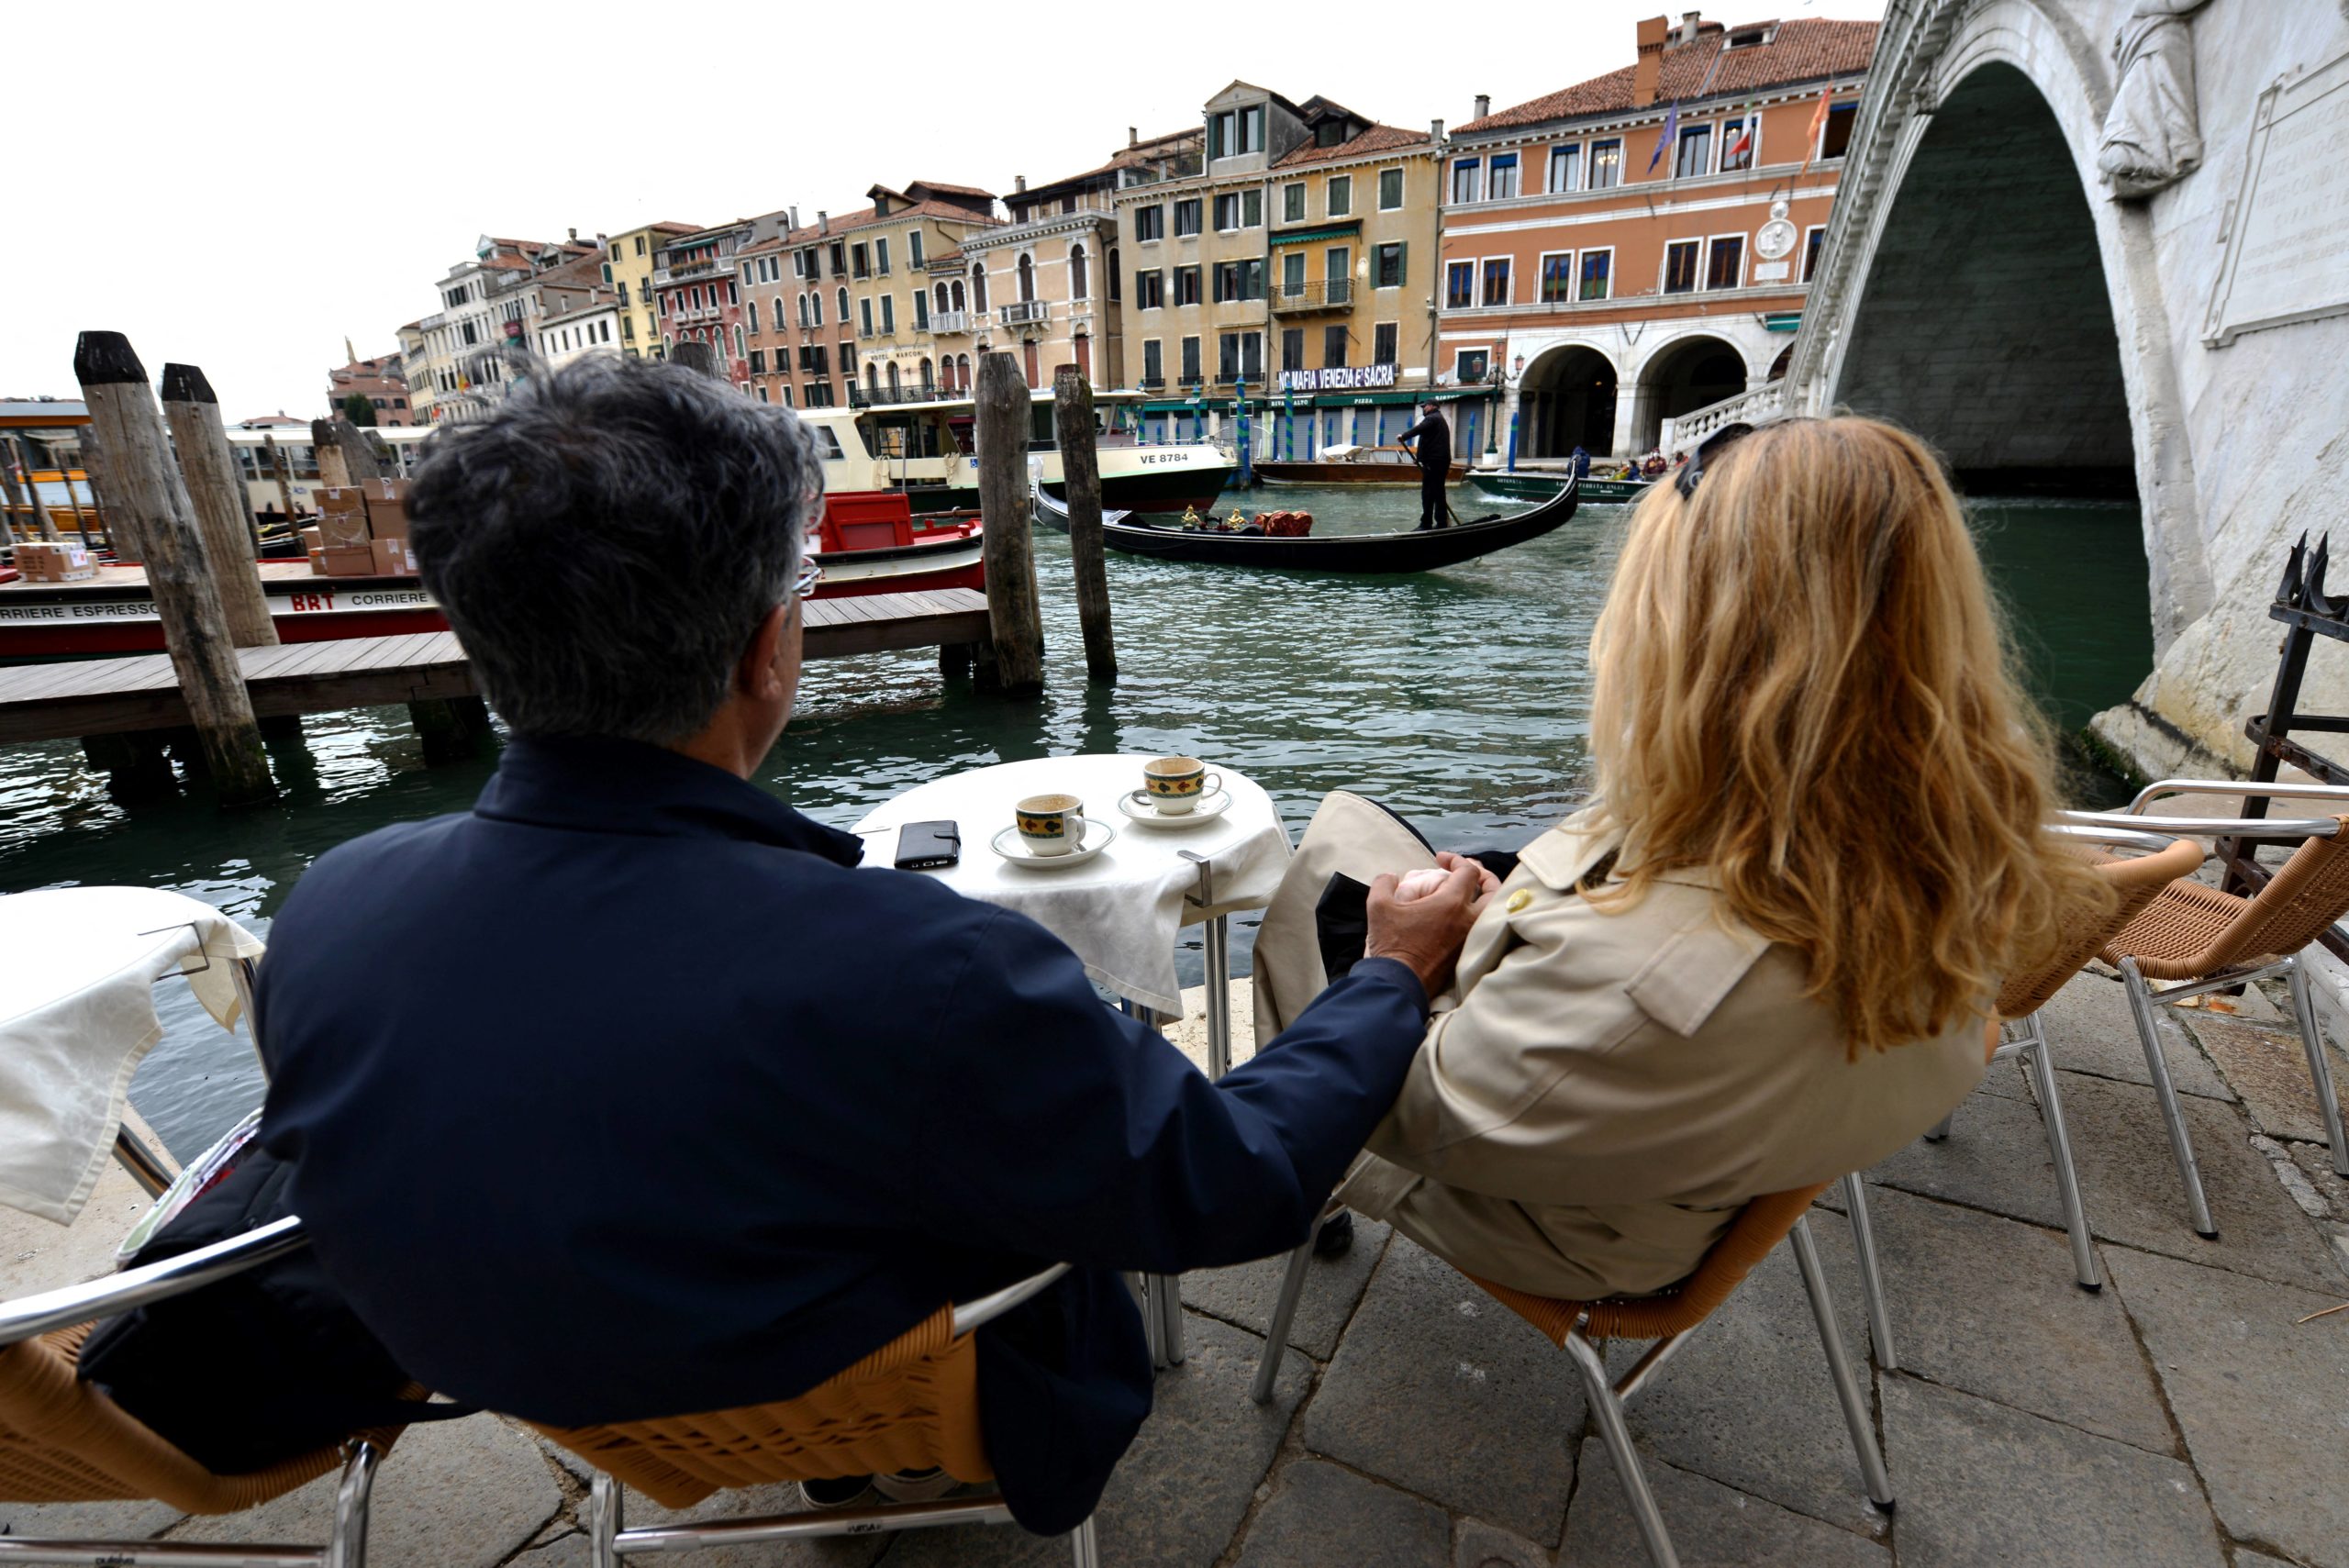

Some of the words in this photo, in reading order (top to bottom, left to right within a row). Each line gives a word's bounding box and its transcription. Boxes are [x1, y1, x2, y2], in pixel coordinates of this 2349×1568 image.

[1292, 370, 1316, 390] MAFIA
[1319, 368, 1353, 389] VENEZIA
[1364, 365, 1394, 386] SACRA
[1141, 454, 1156, 464] VE
[1159, 453, 1188, 462] 8784
[291, 593, 334, 612] BRT
[351, 593, 428, 606] CORRIERE
[0, 606, 65, 619] RRIERE
